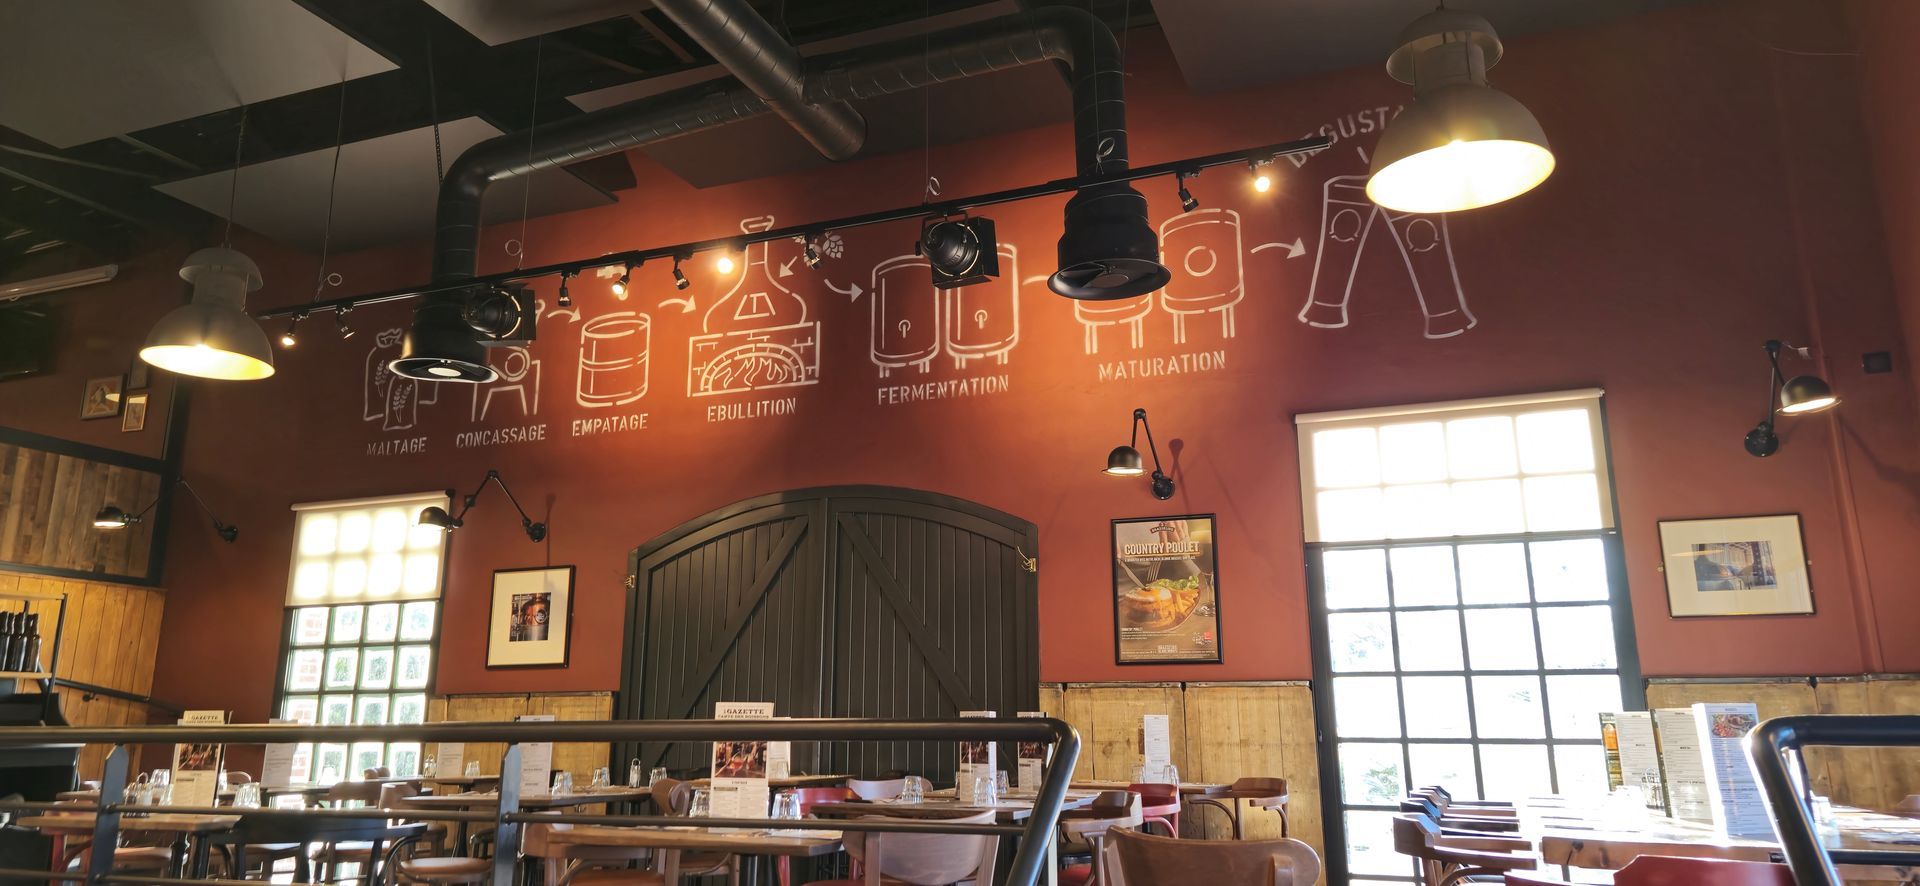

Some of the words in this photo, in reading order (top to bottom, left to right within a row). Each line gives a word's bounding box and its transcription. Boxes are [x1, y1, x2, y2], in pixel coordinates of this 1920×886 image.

[1098, 350, 1226, 381] MATURATION
[878, 374, 1010, 405] FERMENTATION
[707, 397, 797, 422] EBULLITION
[455, 424, 547, 449] CONCASSAGE
[572, 413, 649, 437] EMPATAGE
[366, 437, 428, 456] MALTAGE
[1124, 542, 1164, 555] COUNTRY
[1167, 541, 1200, 553] POULET
